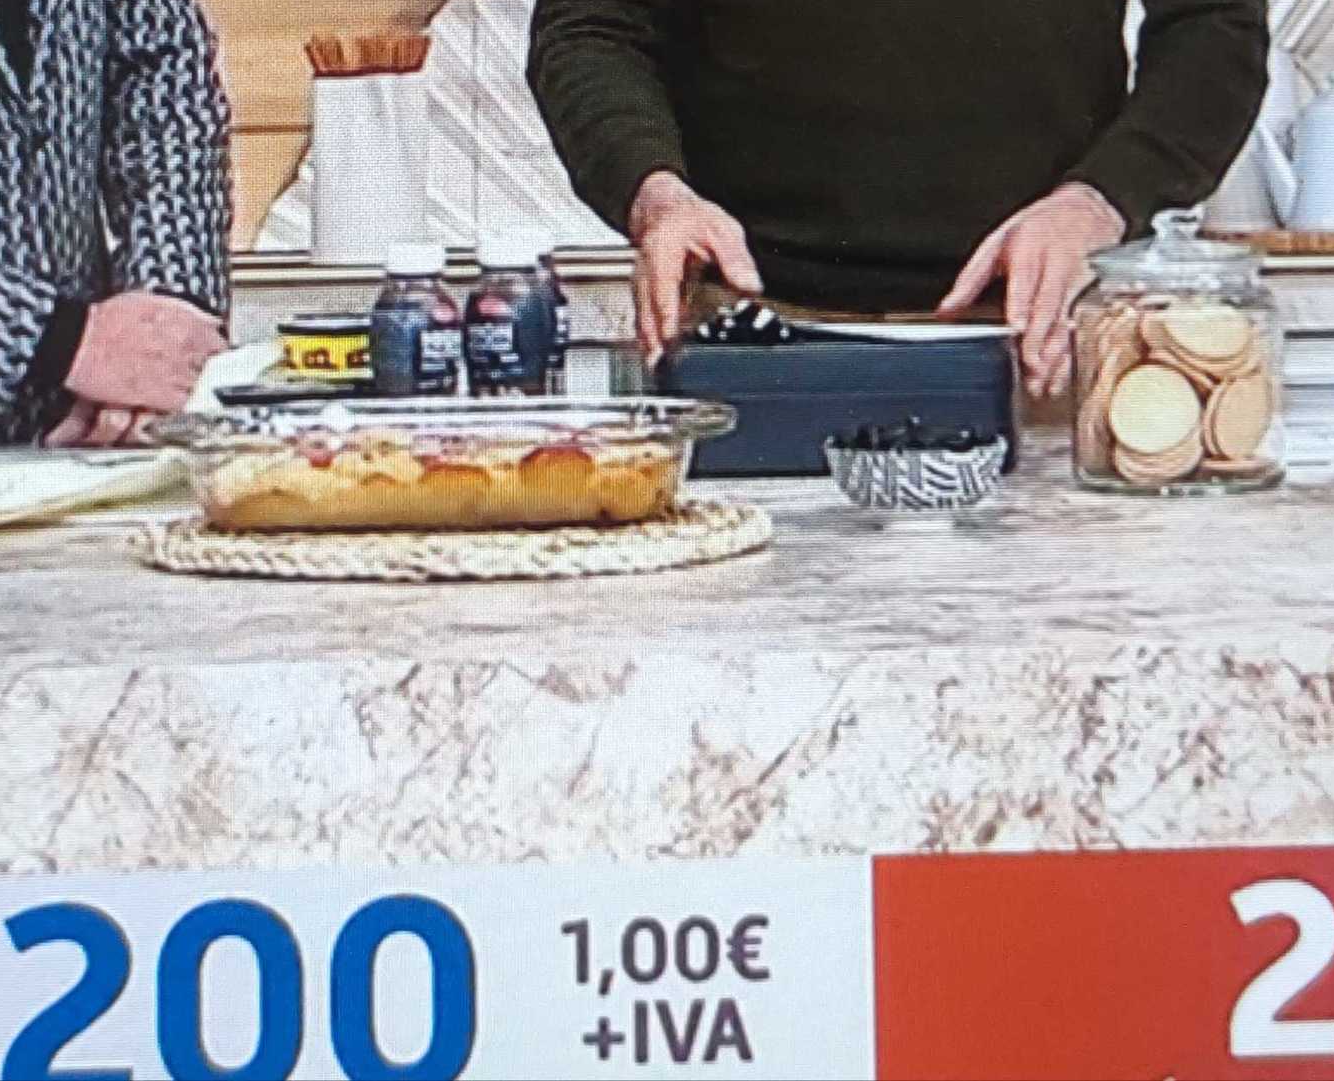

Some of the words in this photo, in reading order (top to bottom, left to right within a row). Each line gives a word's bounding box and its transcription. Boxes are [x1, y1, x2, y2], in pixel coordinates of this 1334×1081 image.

[0, 895, 478, 1081] 200
[561, 915, 770, 995] 1,00€
[582, 999, 754, 1064] +IVA
